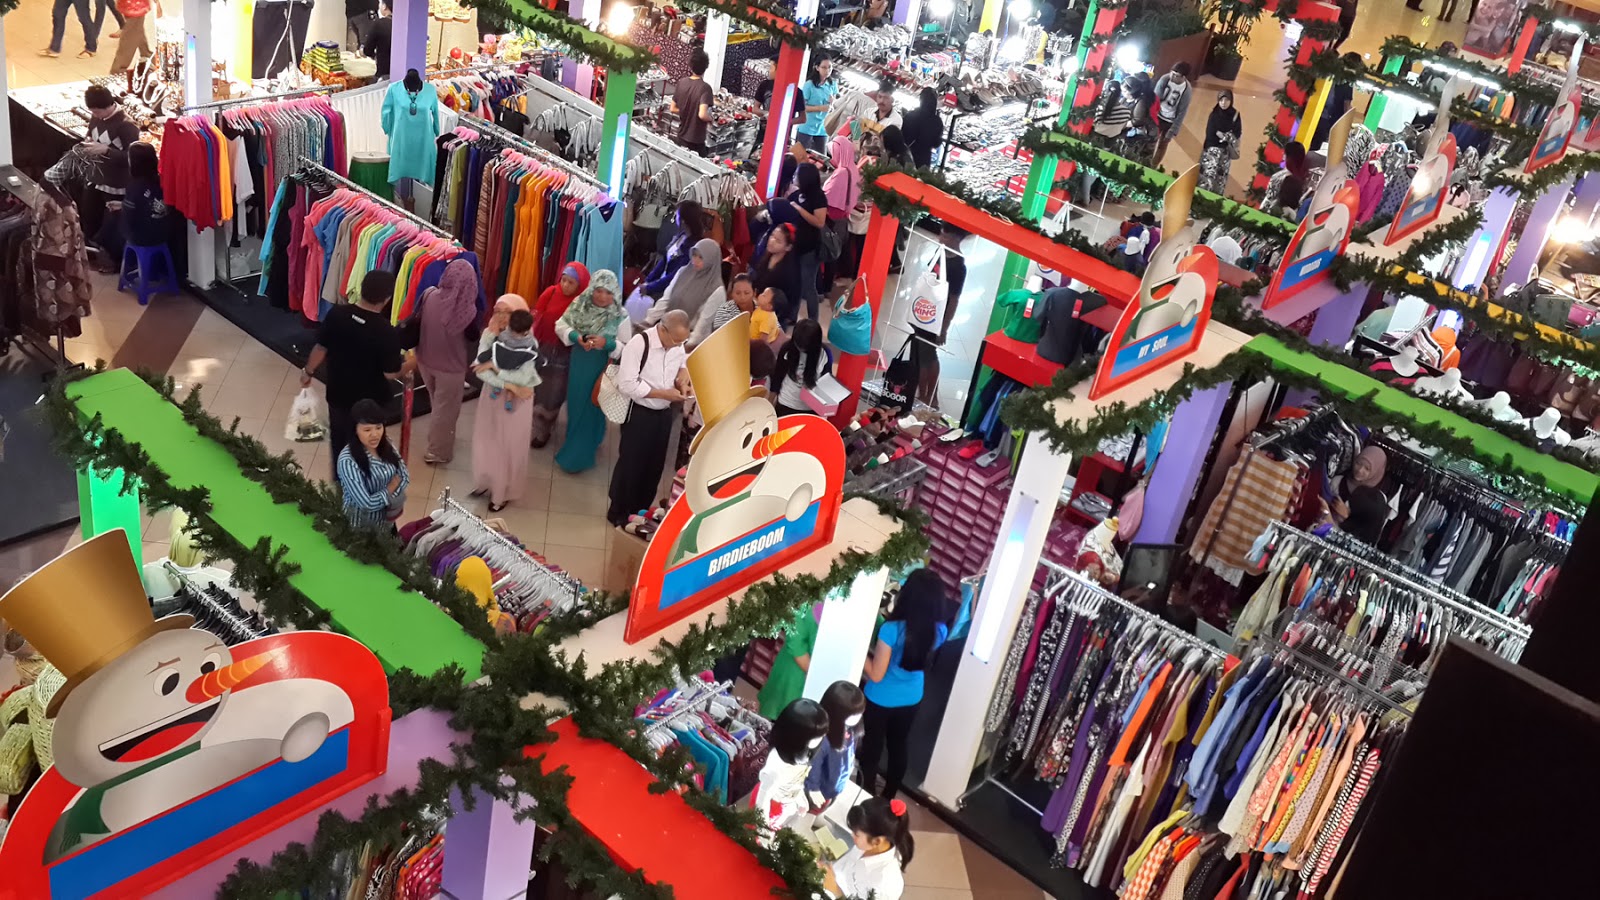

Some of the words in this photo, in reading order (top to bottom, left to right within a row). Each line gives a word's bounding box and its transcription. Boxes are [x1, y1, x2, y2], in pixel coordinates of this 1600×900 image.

[914, 306, 937, 317] KING
[881, 389, 907, 404] BOGOR
[707, 525, 786, 577] BIRDIEBOOM
